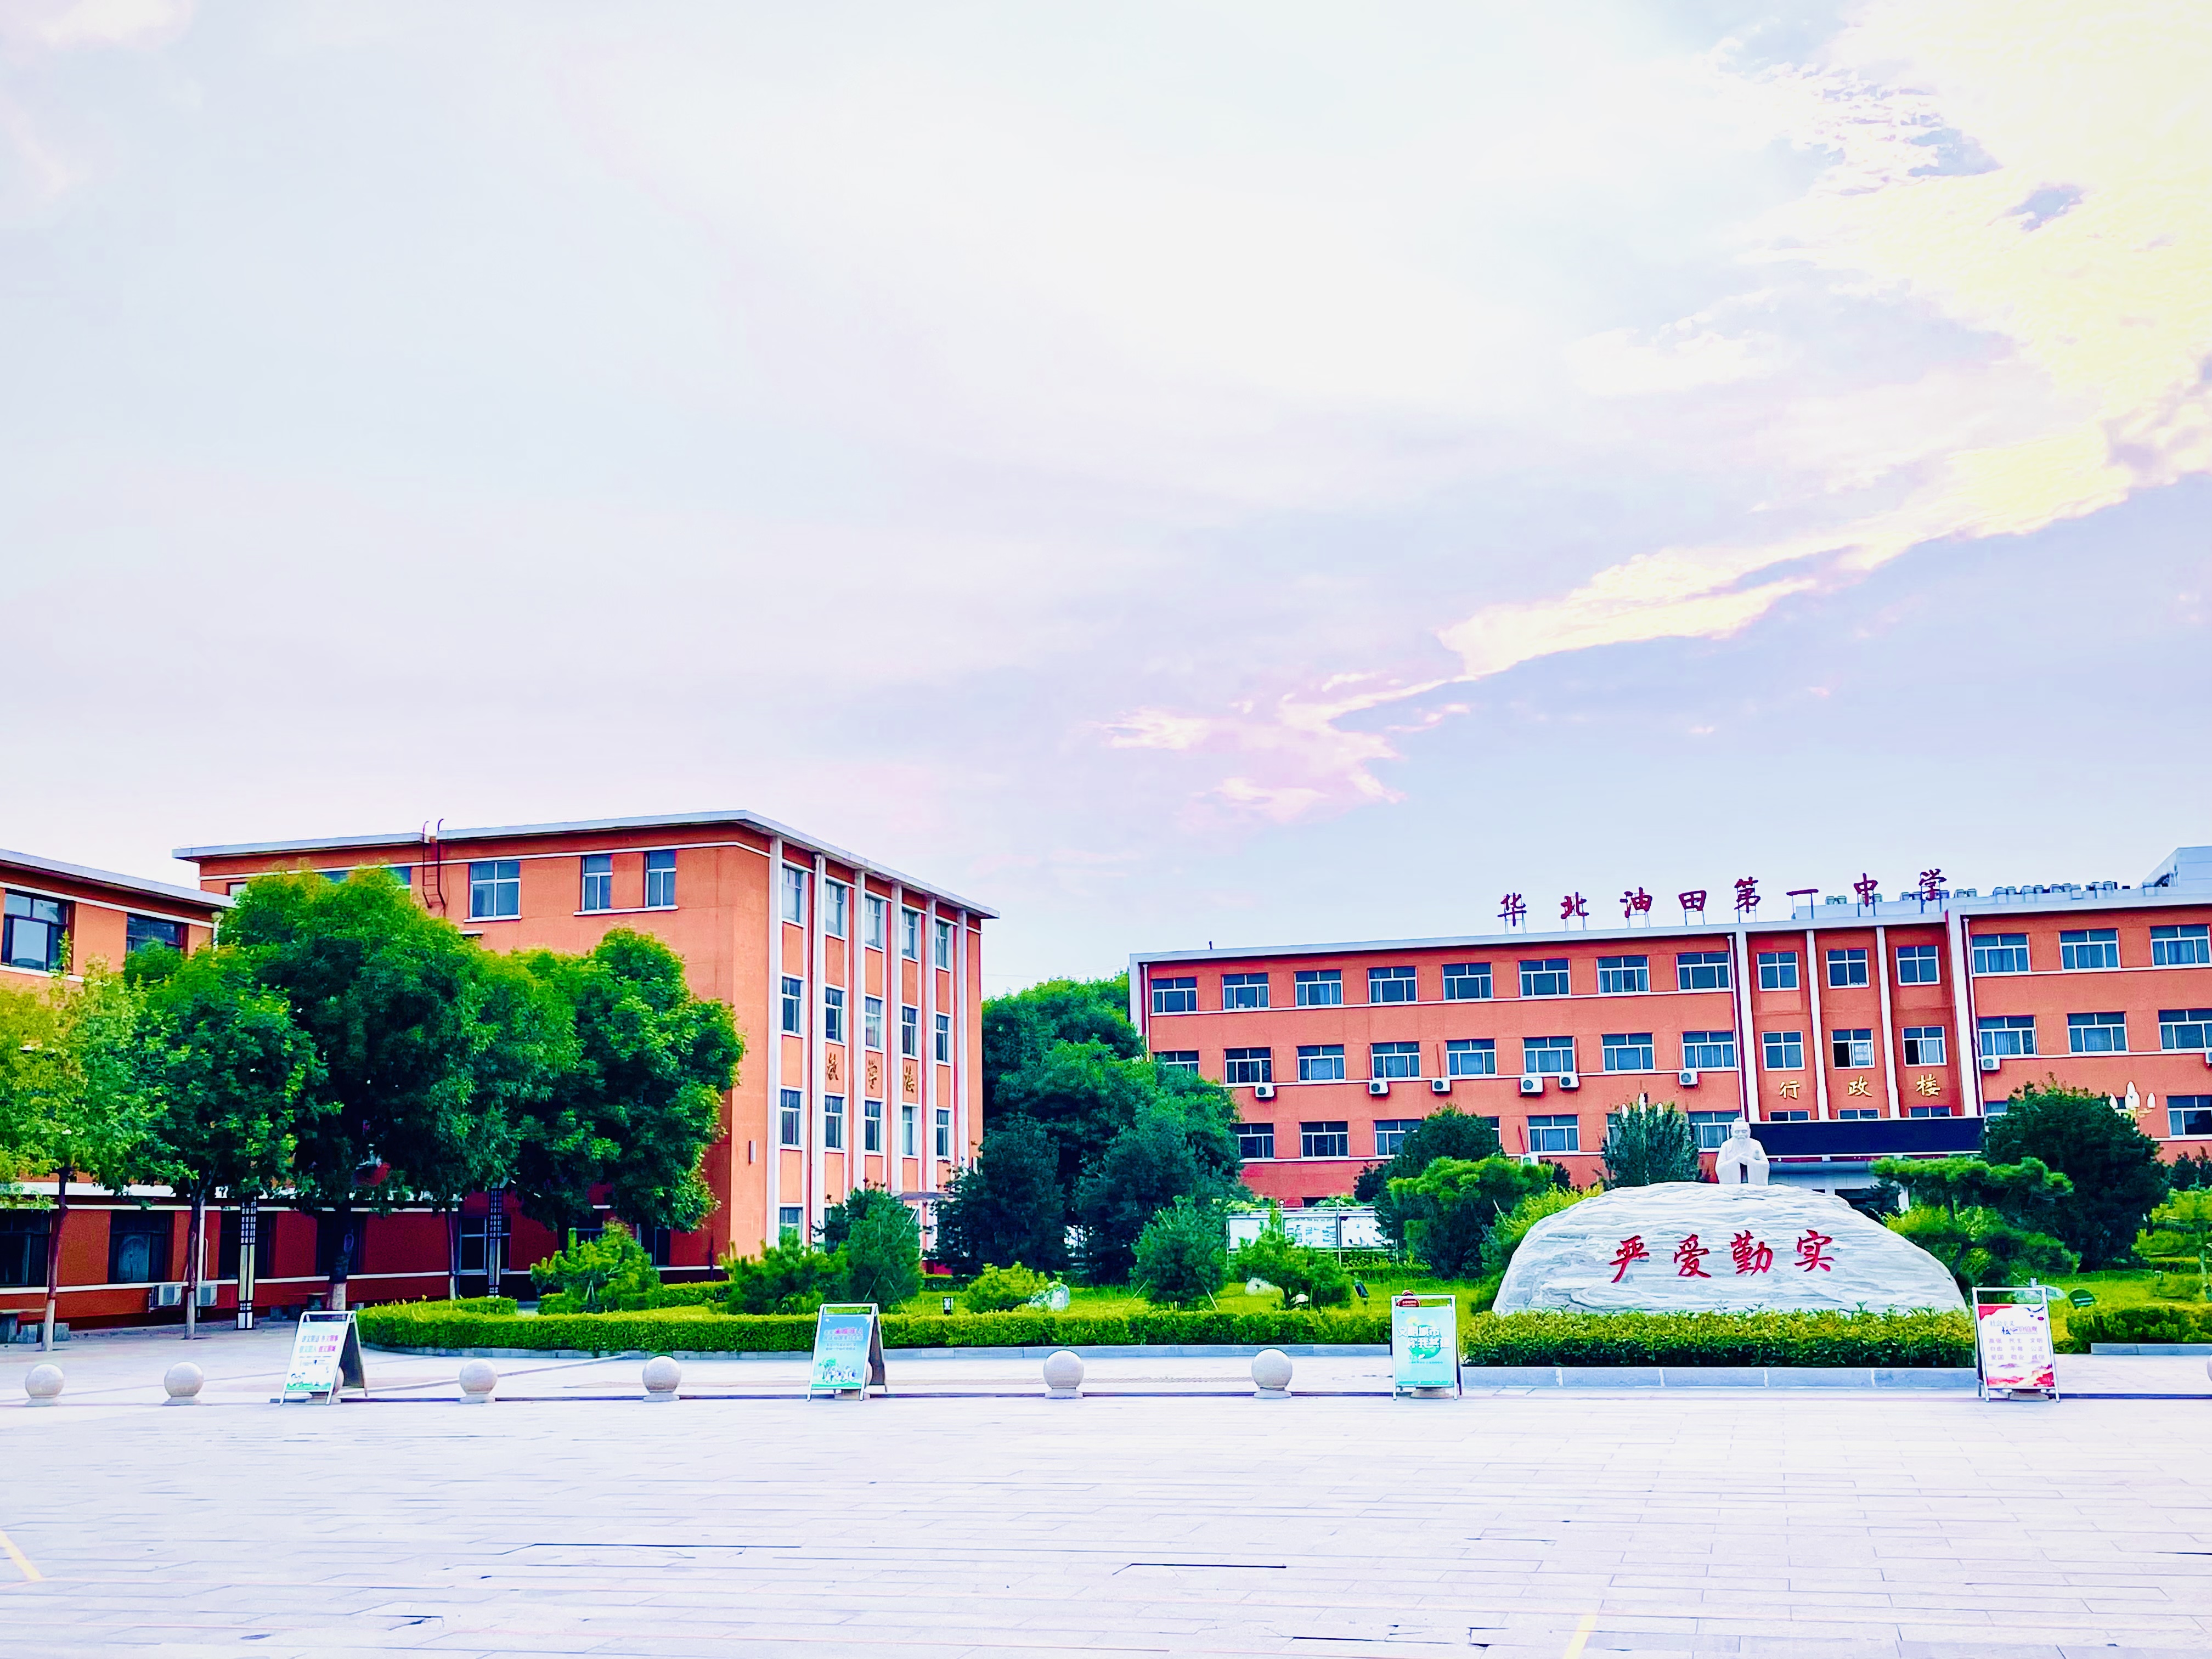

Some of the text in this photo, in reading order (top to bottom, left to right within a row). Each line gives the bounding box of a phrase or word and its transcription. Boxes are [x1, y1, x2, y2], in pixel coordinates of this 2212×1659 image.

[1497, 868, 1947, 927] 华北油田第一中学
[1779, 1073, 1942, 1099] 行政楼
[1609, 1229, 1835, 1283] 严爱勤实
